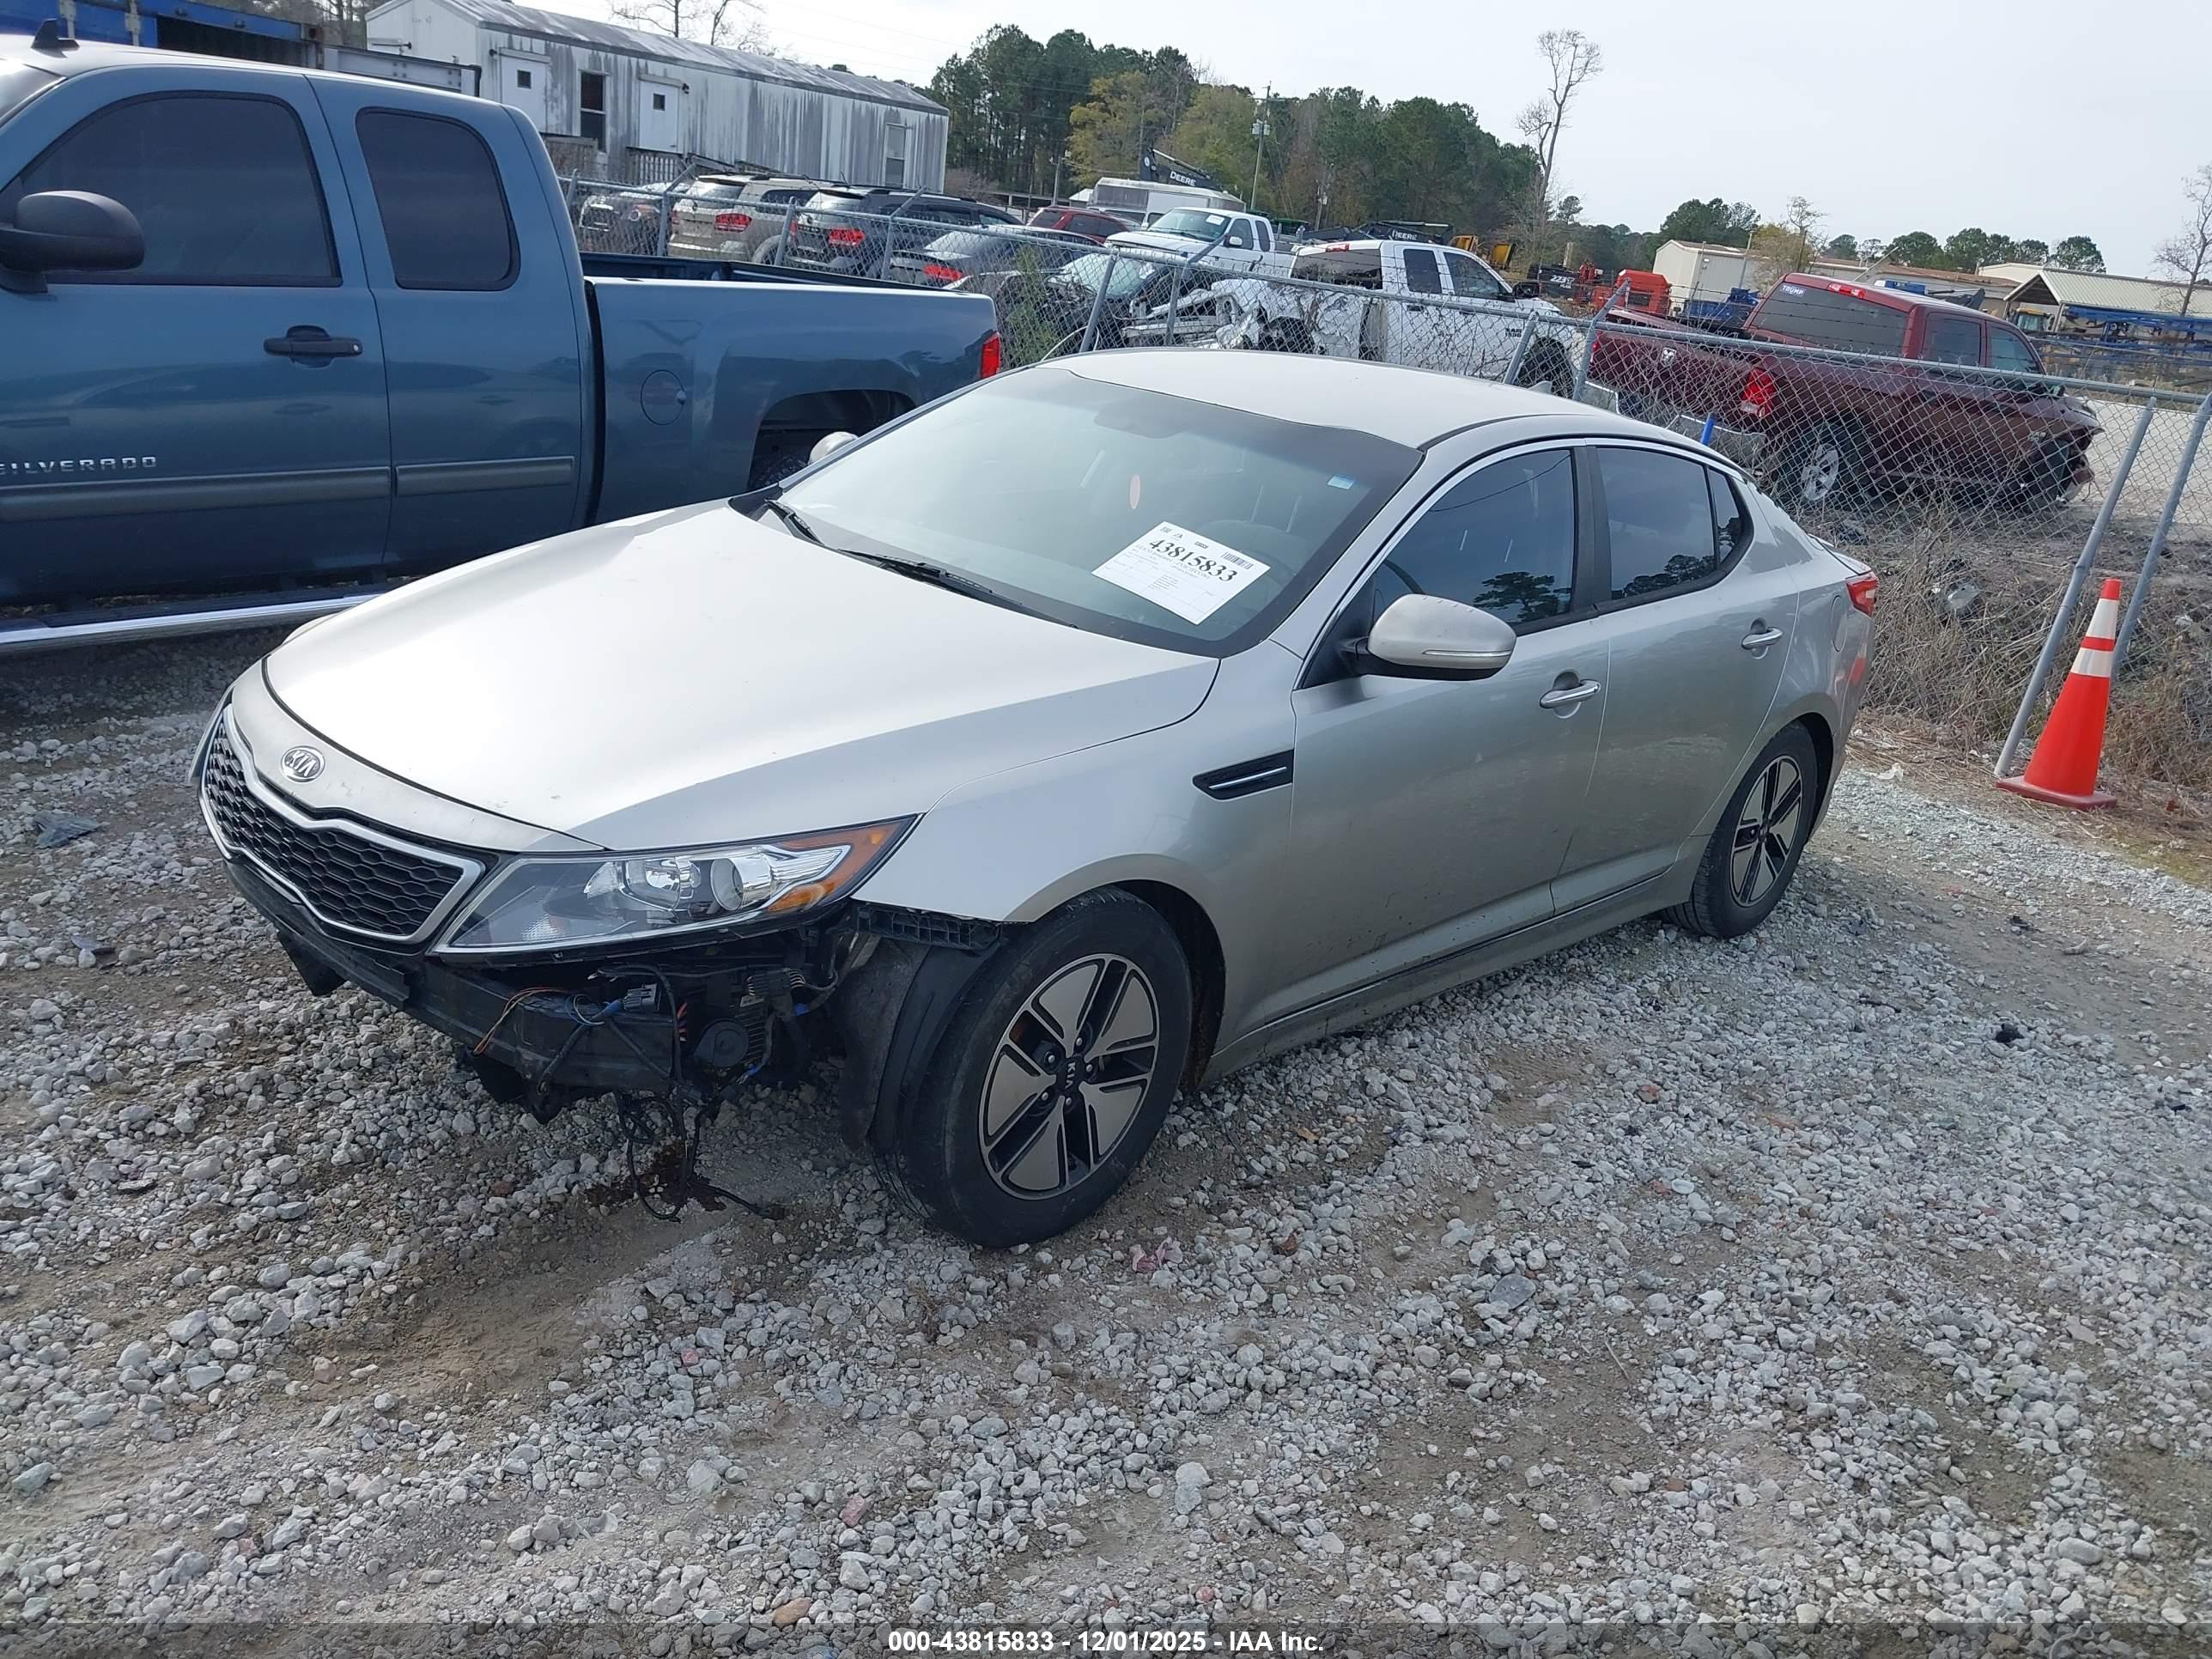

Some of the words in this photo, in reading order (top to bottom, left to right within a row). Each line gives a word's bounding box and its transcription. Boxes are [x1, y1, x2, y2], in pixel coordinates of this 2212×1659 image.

[1170, 171, 1196, 187] DEERE
[1149, 538, 1238, 582] 43815833
[286, 750, 317, 777] KIA
